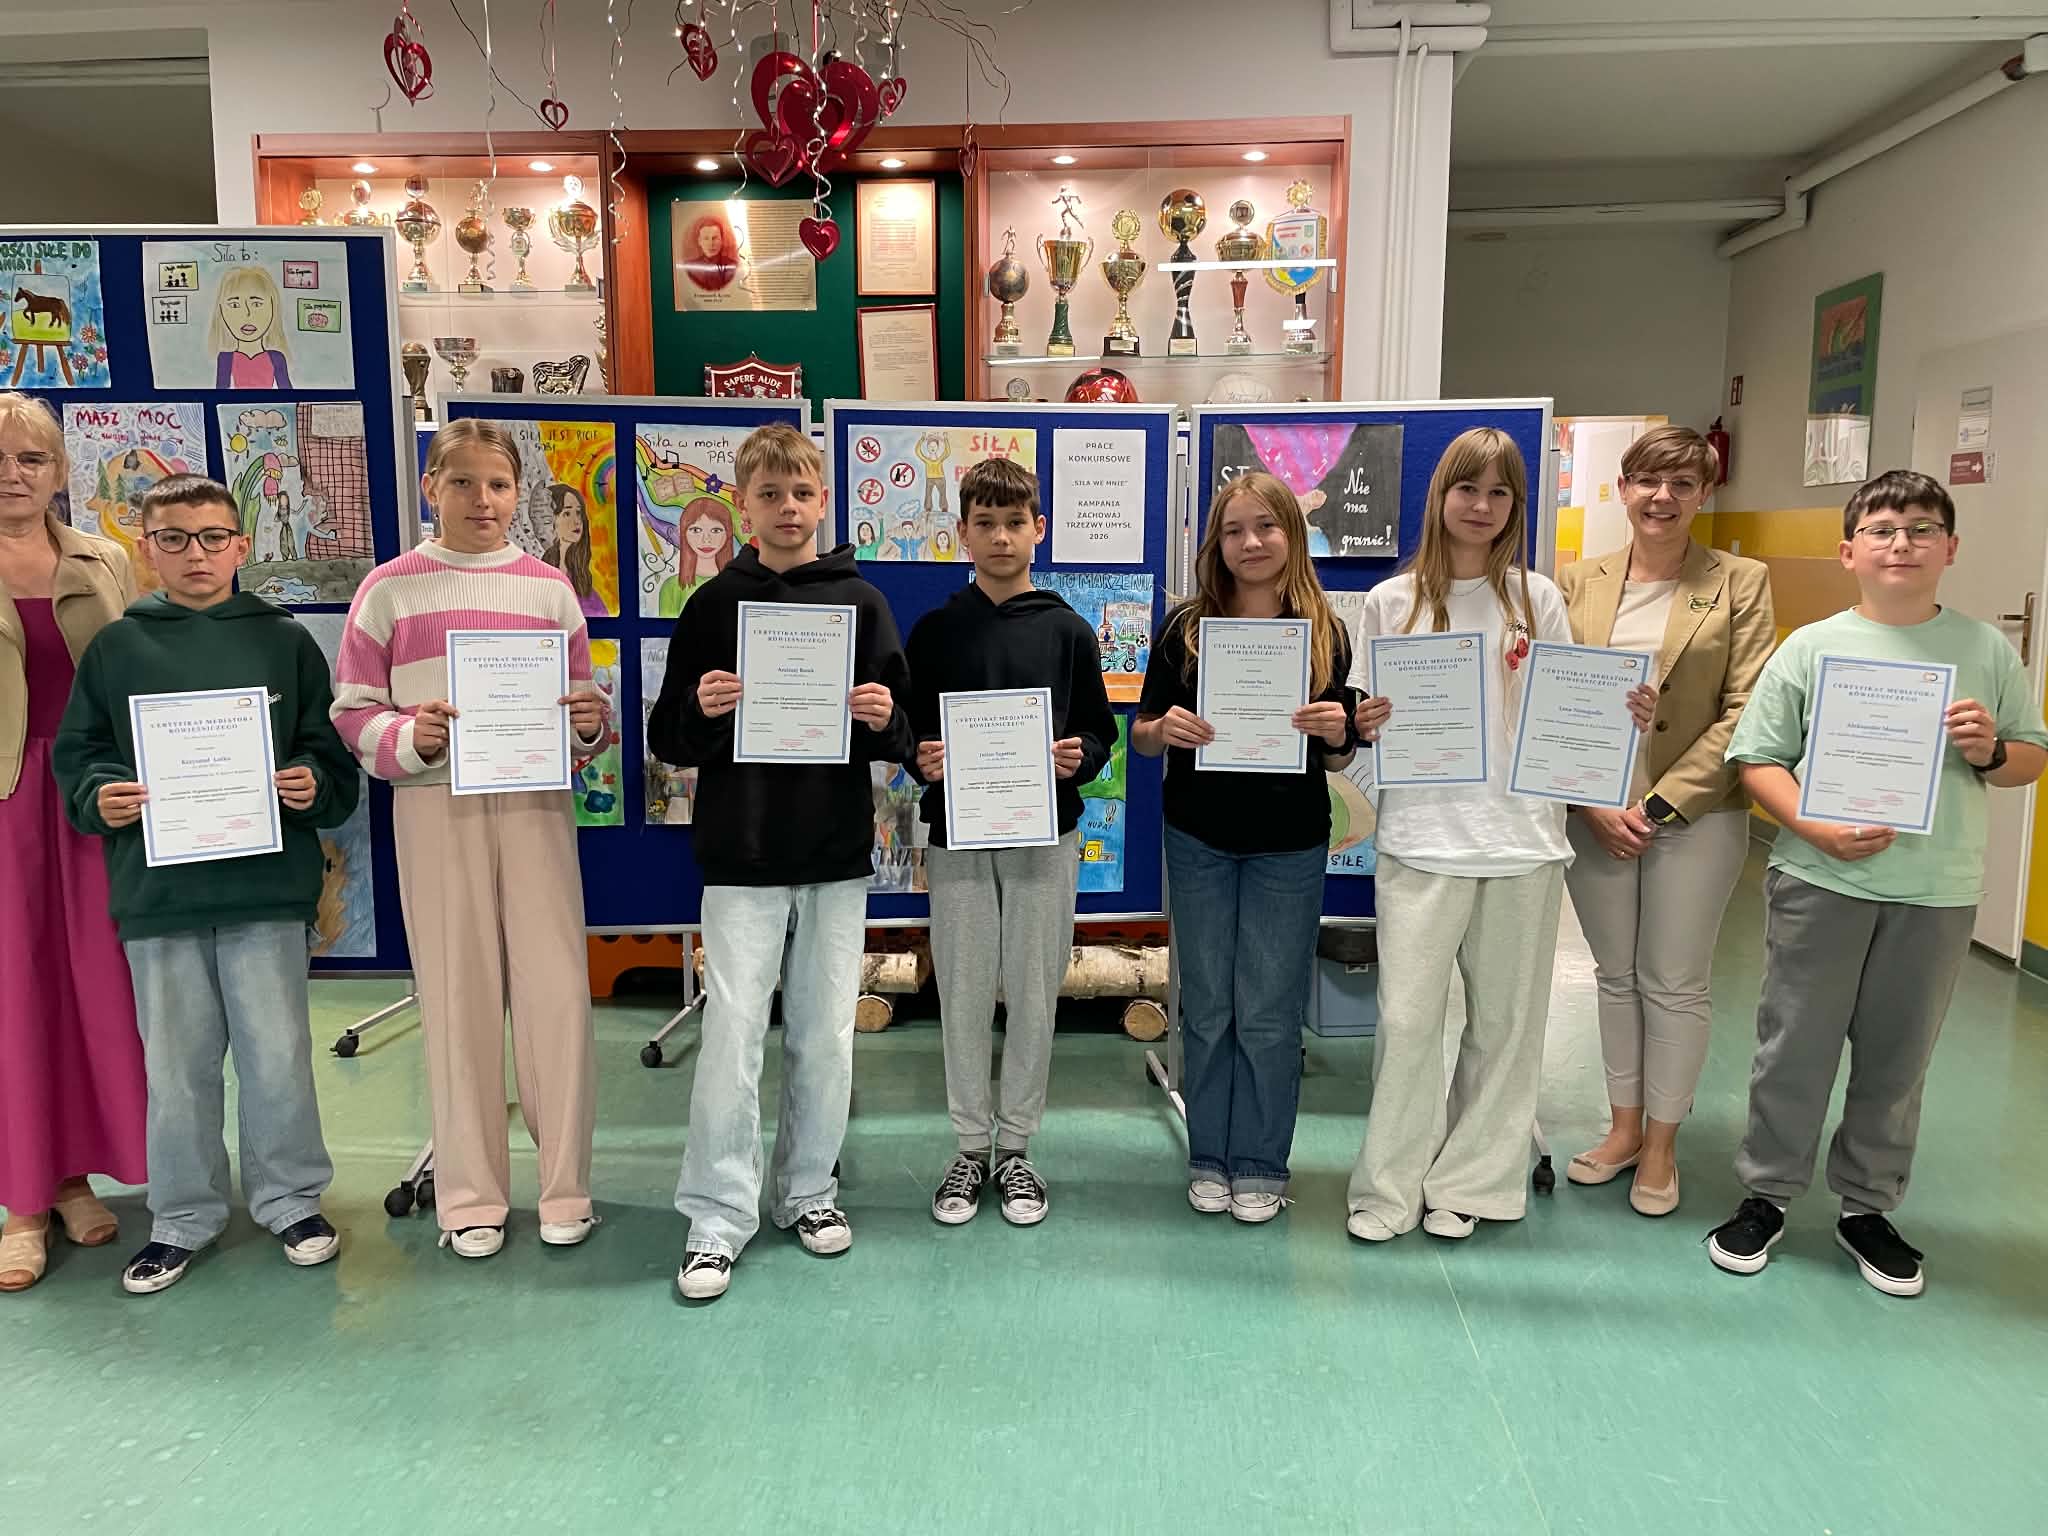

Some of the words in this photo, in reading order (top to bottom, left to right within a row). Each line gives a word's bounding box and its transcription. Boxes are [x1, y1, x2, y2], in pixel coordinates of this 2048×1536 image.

[0, 241, 33, 258] OŚCI
[72, 242, 92, 258] DO
[723, 374, 755, 389] SAPERE
[758, 375, 783, 389] AUDE
[75, 409, 119, 427] MASZ
[138, 409, 182, 429] MOC
[644, 432, 672, 448] Siła
[678, 440, 688, 448] w
[694, 434, 729, 448] moich
[1085, 442, 1114, 450] PRACE
[707, 450, 735, 464] PAS
[1068, 455, 1131, 463] KONKURSOWE
[1343, 467, 1371, 496] Nie
[1077, 500, 1120, 508] KAMPANIA
[1343, 501, 1369, 514] ma
[1076, 511, 1121, 519] ZACHOWAJ
[1340, 524, 1392, 556] granic!
[1057, 575, 1074, 588] TO
